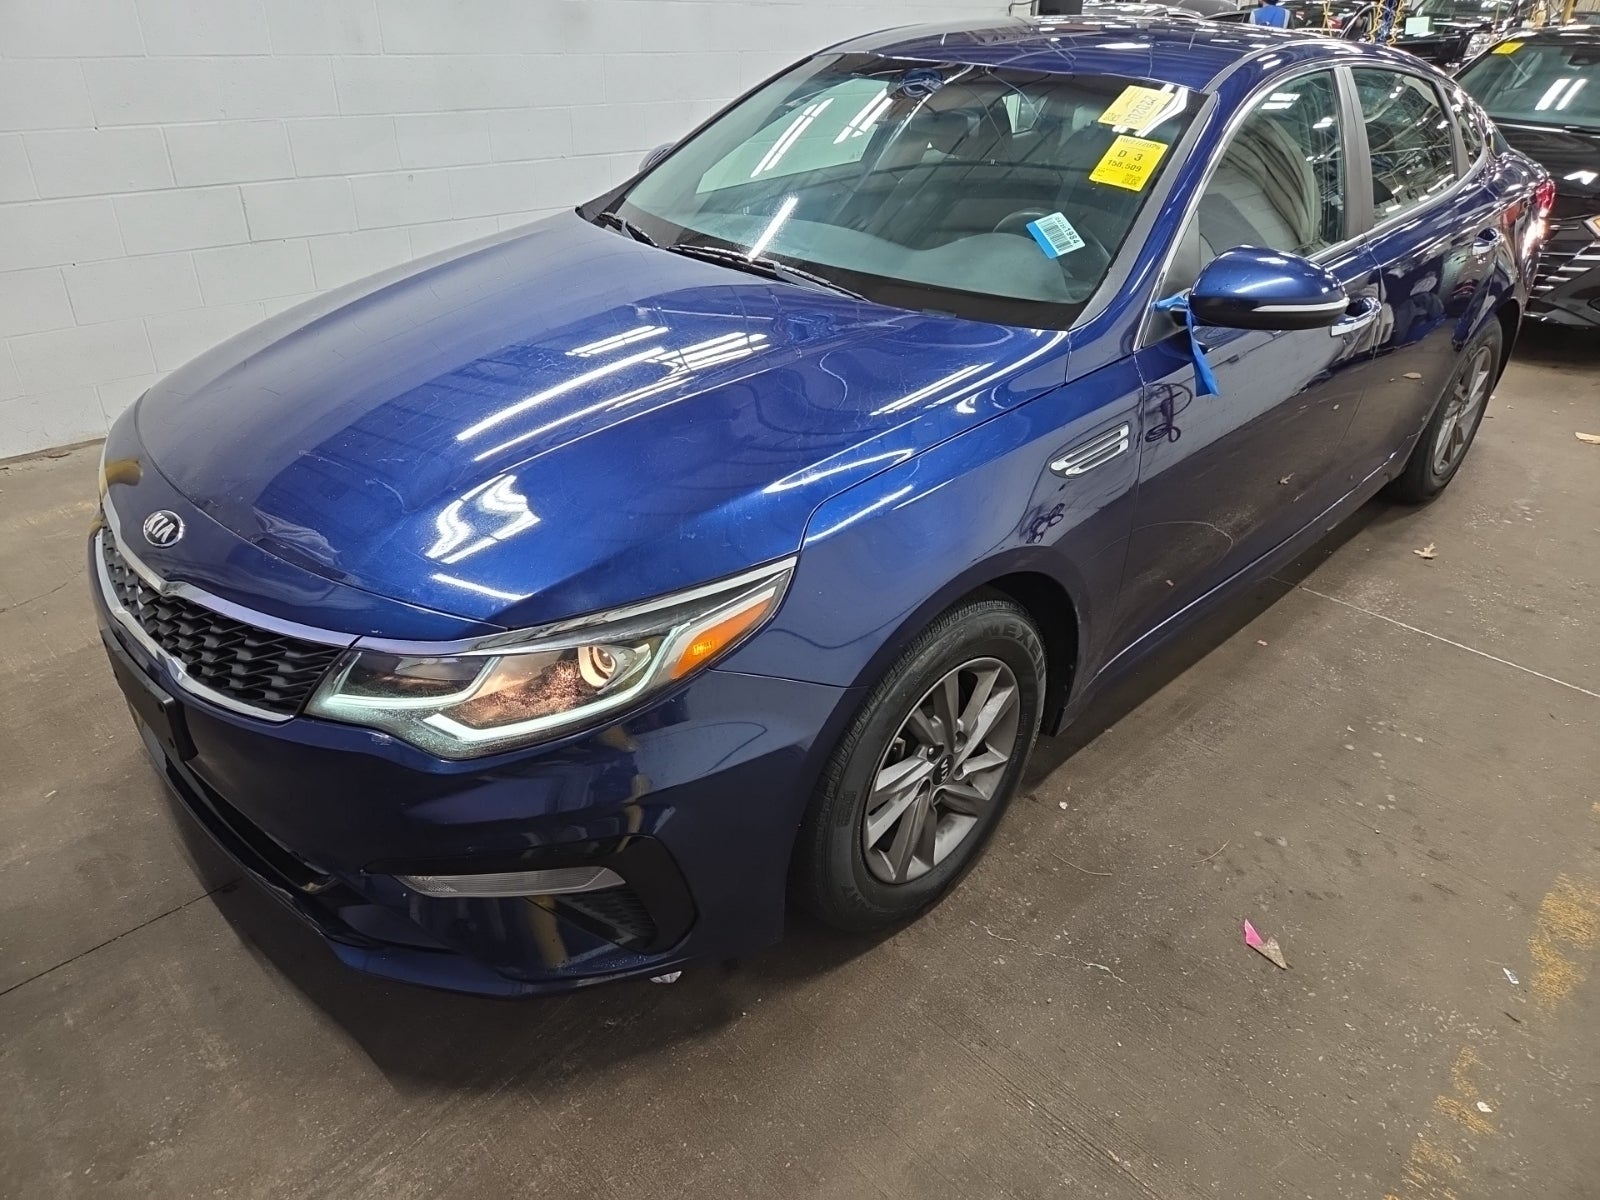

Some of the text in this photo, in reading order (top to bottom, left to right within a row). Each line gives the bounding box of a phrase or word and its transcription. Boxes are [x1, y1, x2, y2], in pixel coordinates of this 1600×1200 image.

[1117, 150, 1143, 162] D 3
[146, 512, 176, 544] KIA
